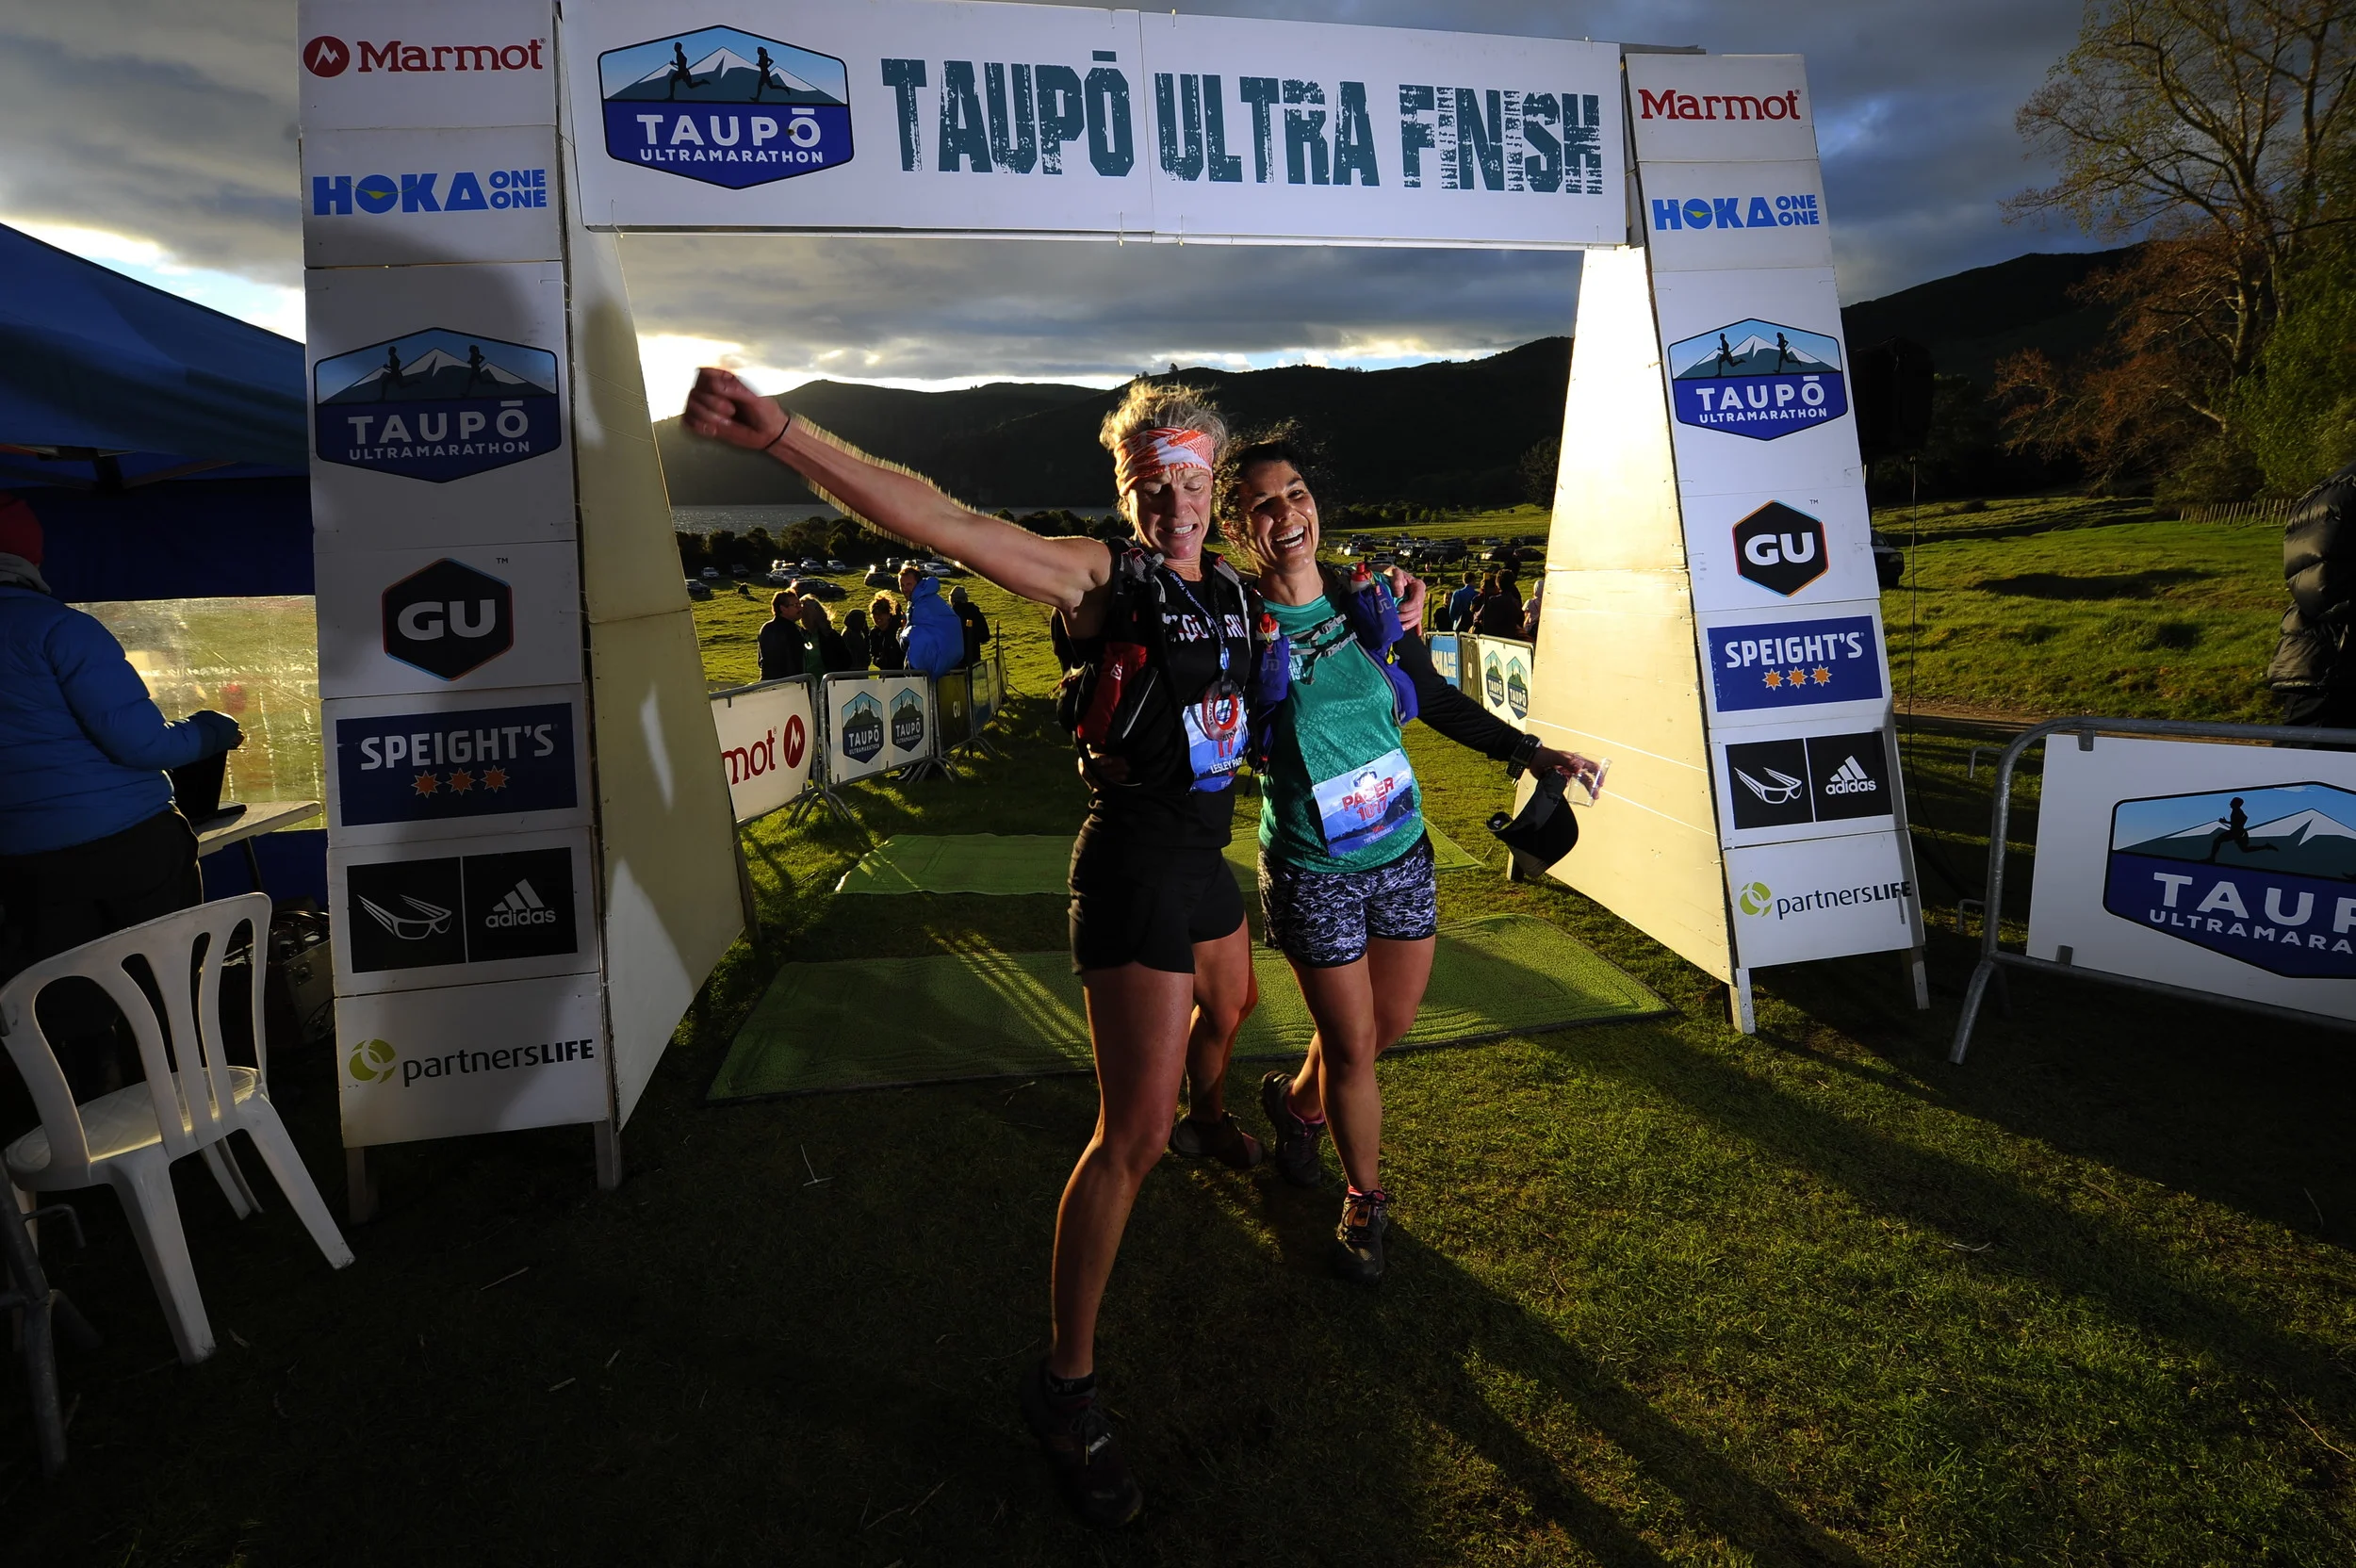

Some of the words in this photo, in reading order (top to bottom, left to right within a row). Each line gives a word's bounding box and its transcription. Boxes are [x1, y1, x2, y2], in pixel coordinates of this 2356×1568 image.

[357, 39, 544, 73] Marmot
[1637, 89, 1801, 121] Marmot
[636, 108, 821, 148] TAUPŌ
[880, 51, 1134, 177] TAUPŌ
[1154, 72, 1381, 188] ULTRA
[1399, 84, 1603, 196] FINISH
[640, 149, 824, 164] ULTRAMARATHON
[313, 172, 489, 216] HOKA
[489, 169, 546, 188] ONE
[489, 188, 547, 209] ONE
[1651, 197, 1777, 230] HOKA
[1775, 194, 1818, 210] ONE
[1778, 210, 1820, 226] ONE
[1696, 376, 1824, 411] TAUPŌ
[348, 400, 529, 443] TAUPŌ
[1699, 408, 1827, 424] ULTRAMARATHON
[349, 439, 530, 461] ULTRAMARATHON
[1744, 531, 1815, 565] GU
[397, 598, 497, 641] GU
[1726, 631, 1863, 669] SPEIGHT'S
[848, 725, 879, 747] TAUPŌ
[895, 718, 921, 737] TAUPŌ
[360, 724, 554, 771] SPEIGHT'S
[722, 729, 777, 786] mot
[1210, 760, 1233, 774] LESLEY
[1825, 779, 1876, 795] adidas
[485, 907, 556, 928] adidas
[1776, 881, 1912, 920] partnersLIFE
[2153, 872, 2356, 934] TAUP
[2150, 909, 2354, 955] ULTRAMARA
[403, 1038, 595, 1087] partnersLIFE
